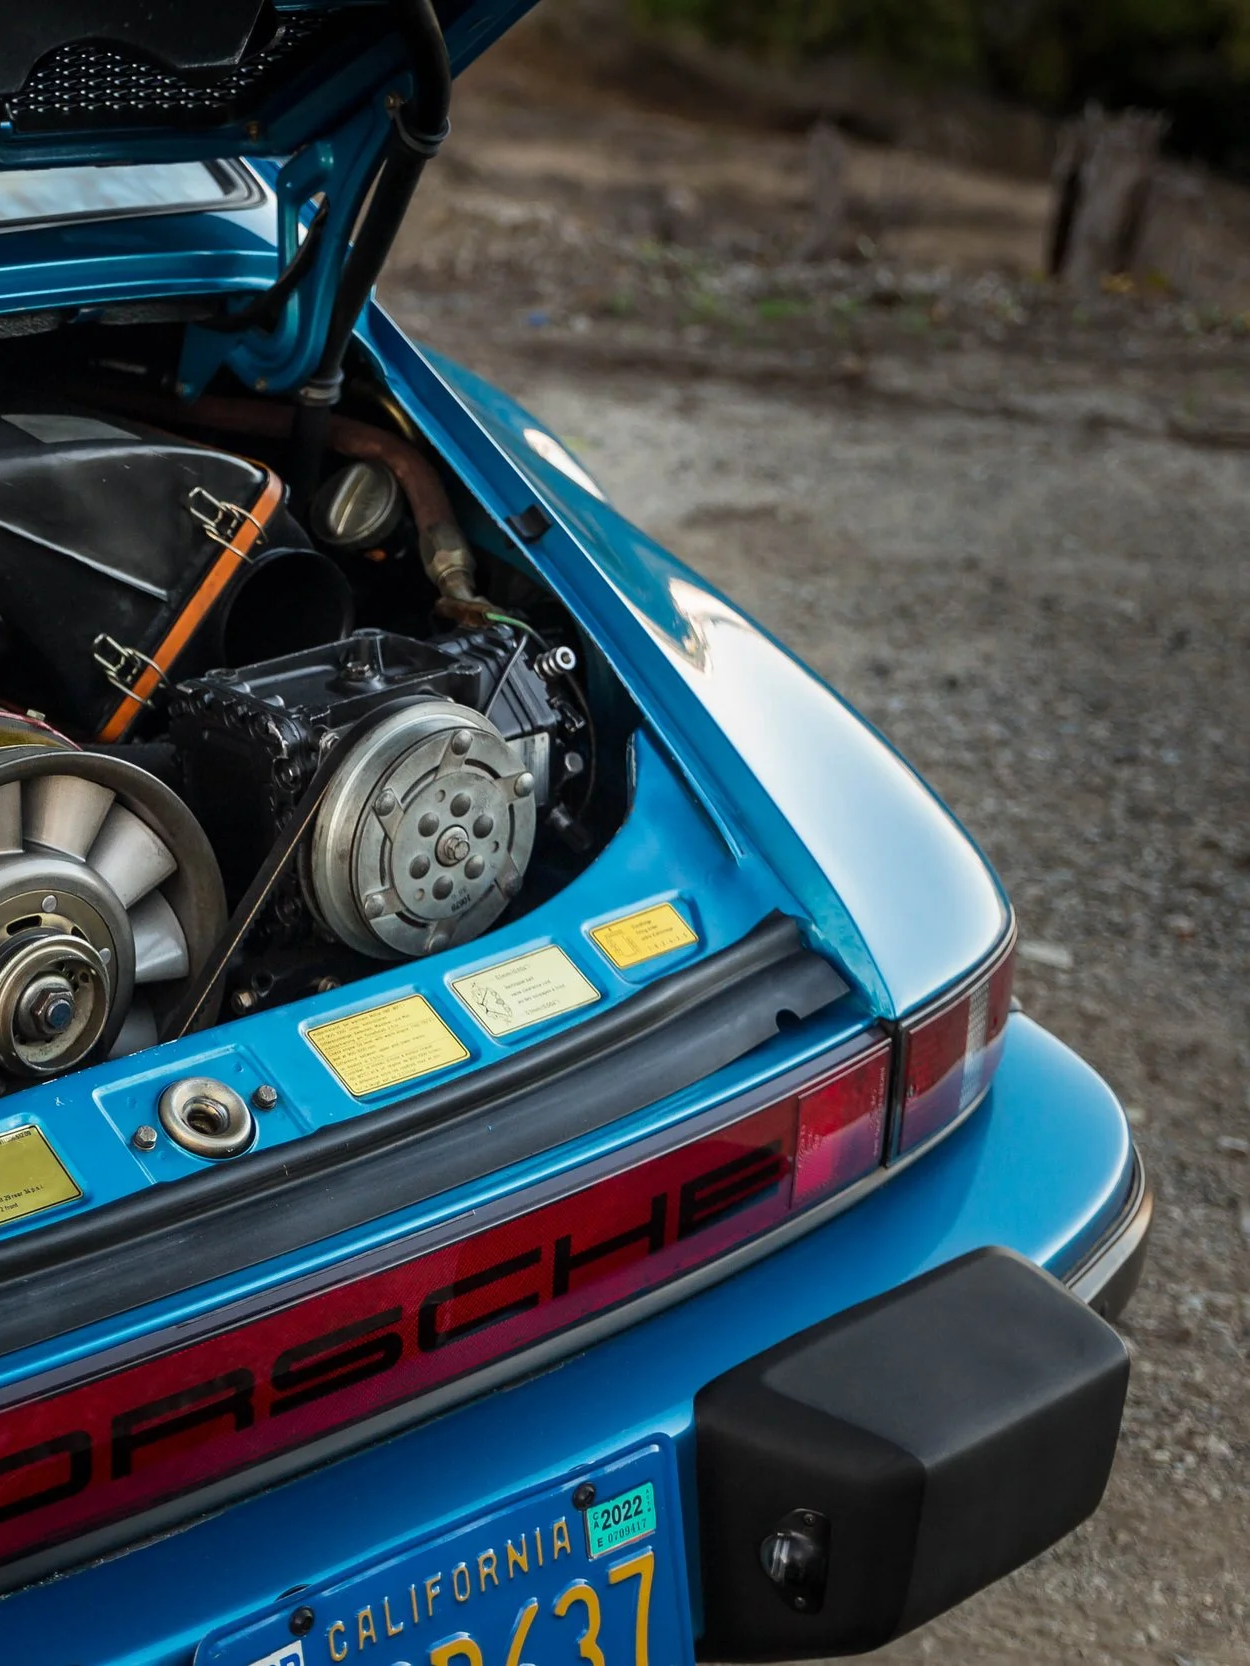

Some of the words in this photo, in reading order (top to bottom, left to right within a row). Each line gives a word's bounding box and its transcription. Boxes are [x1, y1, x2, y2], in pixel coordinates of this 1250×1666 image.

[11, 1191, 23, 1199] rear
[4, 1202, 19, 1211] front
[601, 1495, 643, 1531] 2022
[597, 1538, 604, 1547] E
[327, 1516, 572, 1662] CALIFORNIA
